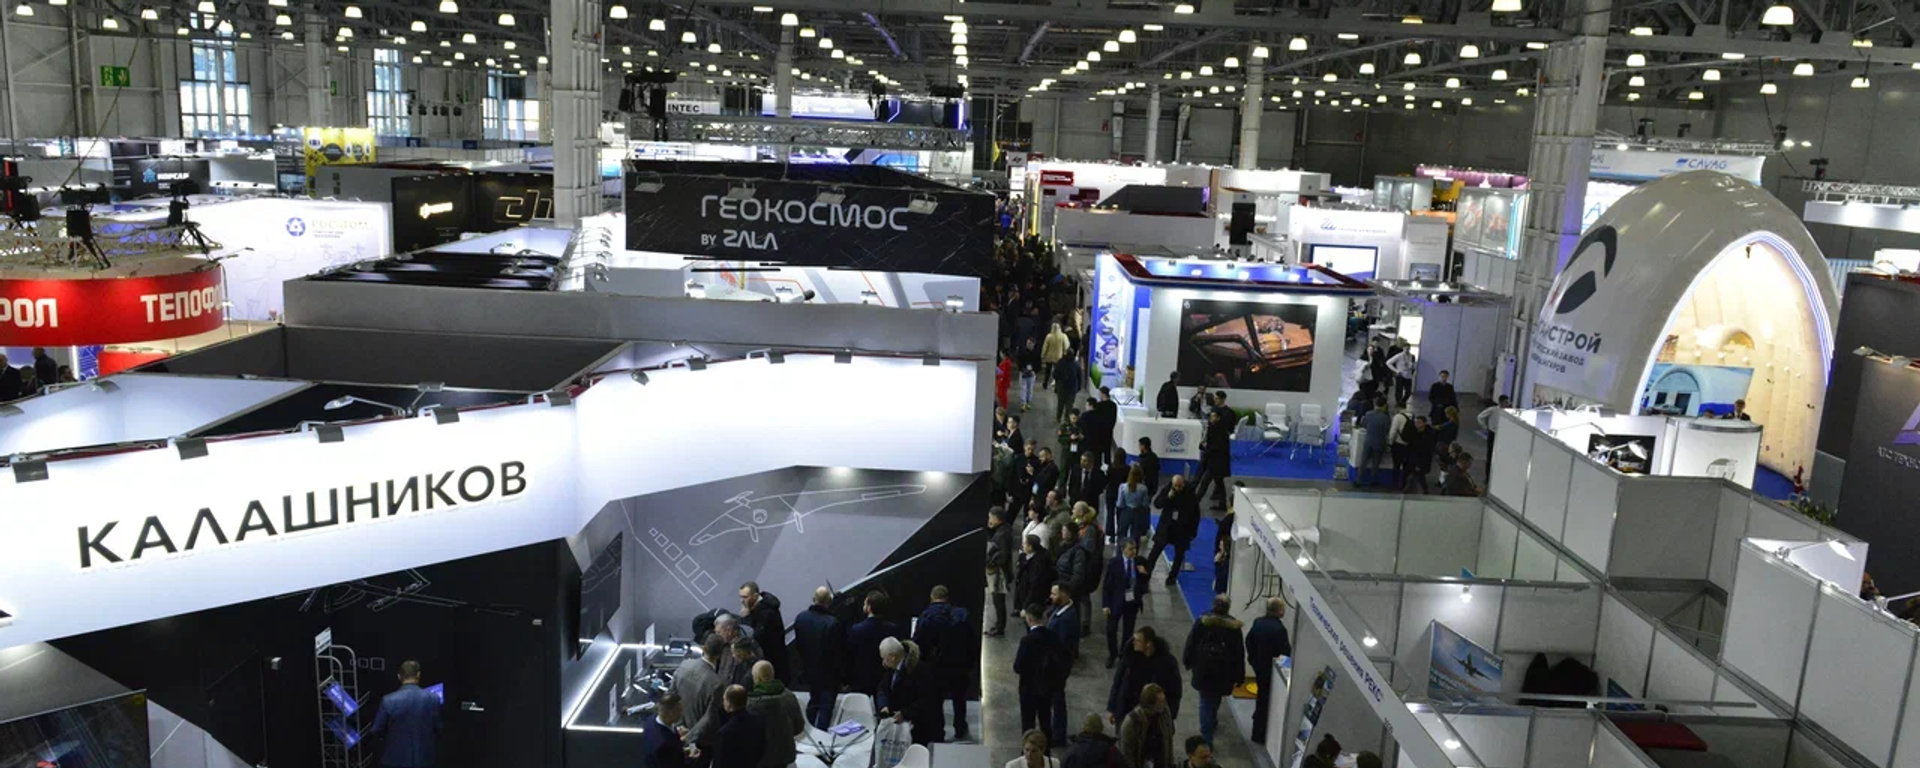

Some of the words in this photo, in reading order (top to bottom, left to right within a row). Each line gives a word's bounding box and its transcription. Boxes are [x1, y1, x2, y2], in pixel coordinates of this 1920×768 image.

[667, 103, 700, 113] INTEC
[1688, 158, 1728, 170] CAVAG
[701, 195, 909, 231] ГЕОКОСМОС
[701, 234, 717, 246] BY
[723, 229, 779, 251] ZALA
[78, 460, 527, 568] КАЛАШНИКОВ
